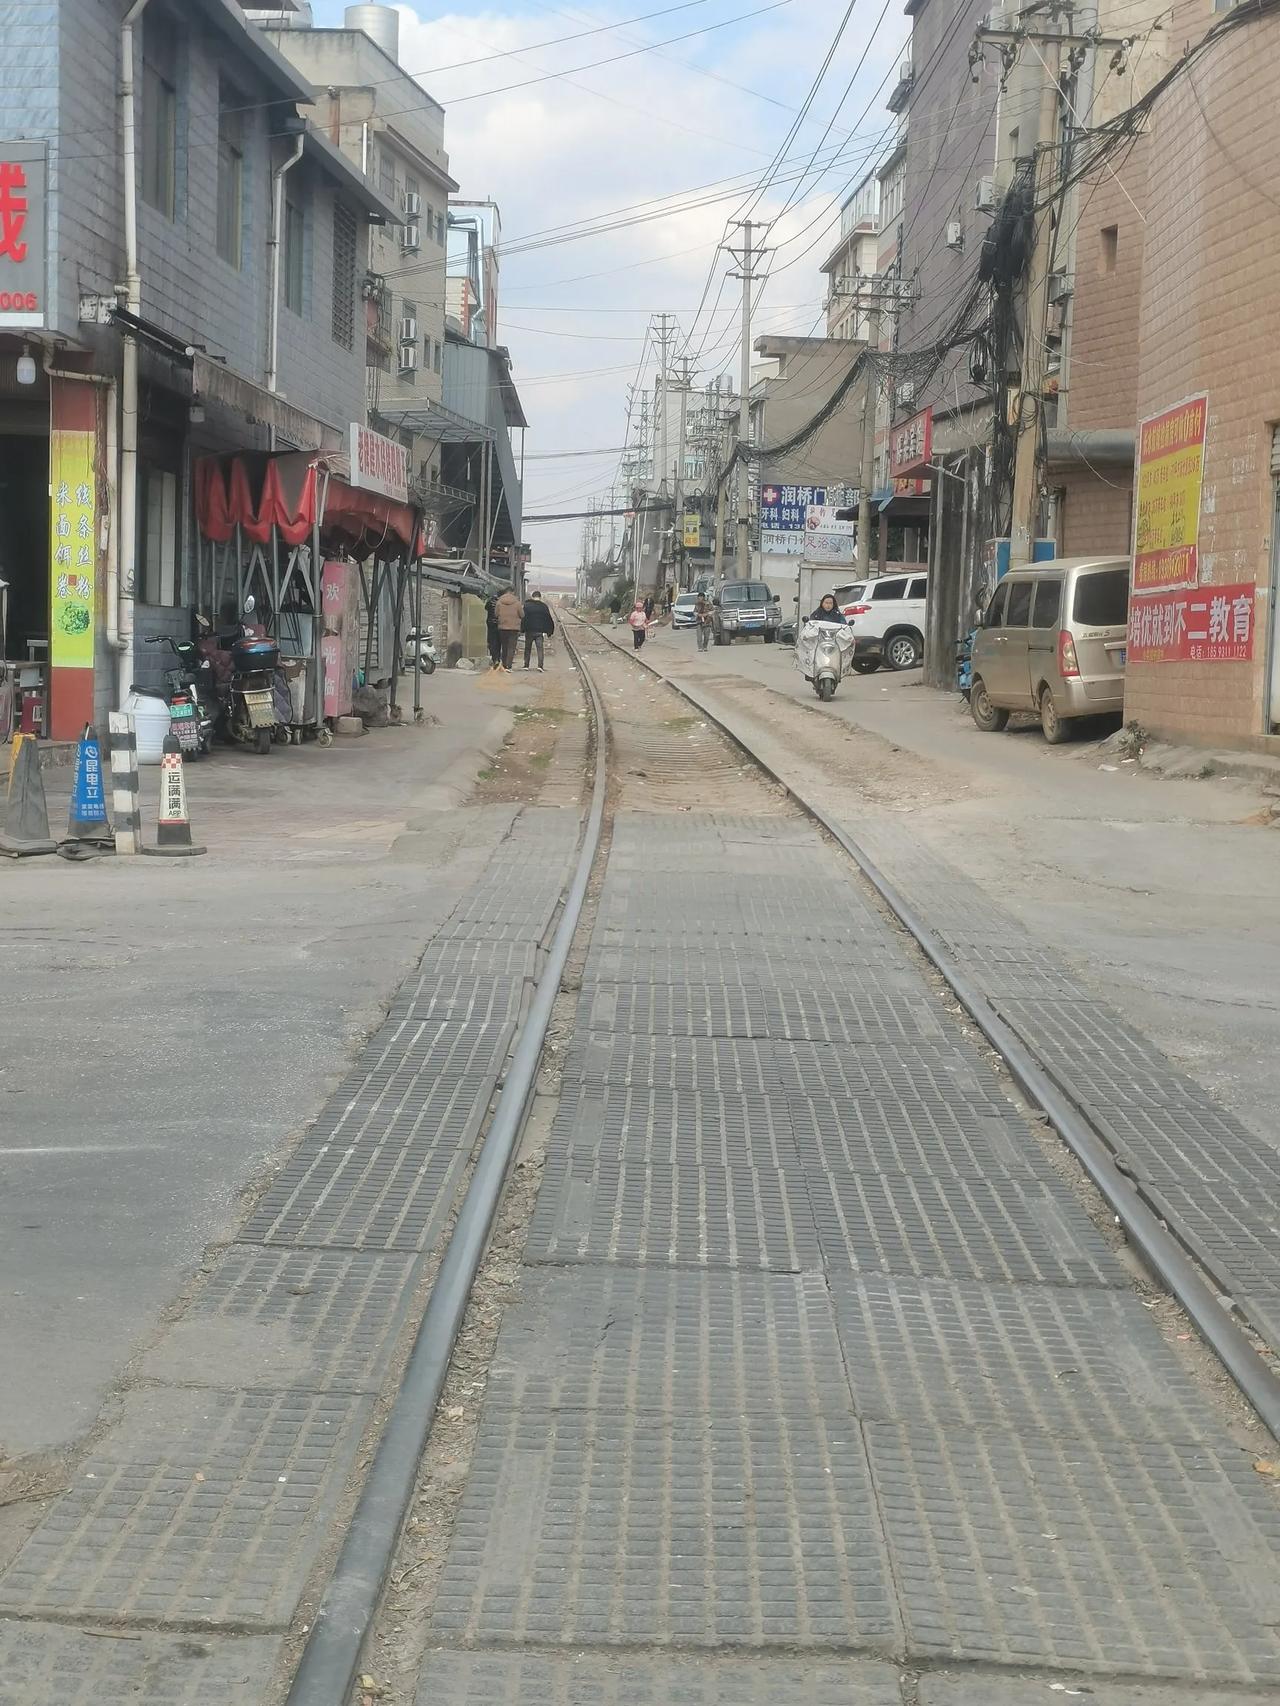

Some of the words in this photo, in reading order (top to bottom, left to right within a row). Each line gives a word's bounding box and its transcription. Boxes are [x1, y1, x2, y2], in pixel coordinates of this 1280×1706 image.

[56, 482, 92, 509] 米线
[56, 513, 93, 540] 面条
[781, 508, 799, 522] 妇科
[55, 544, 92, 568] 饵丝
[56, 573, 92, 600] 卷粉
[1129, 594, 1253, 648] 培优就到不二教育
[168, 771, 181, 810] 运满满
